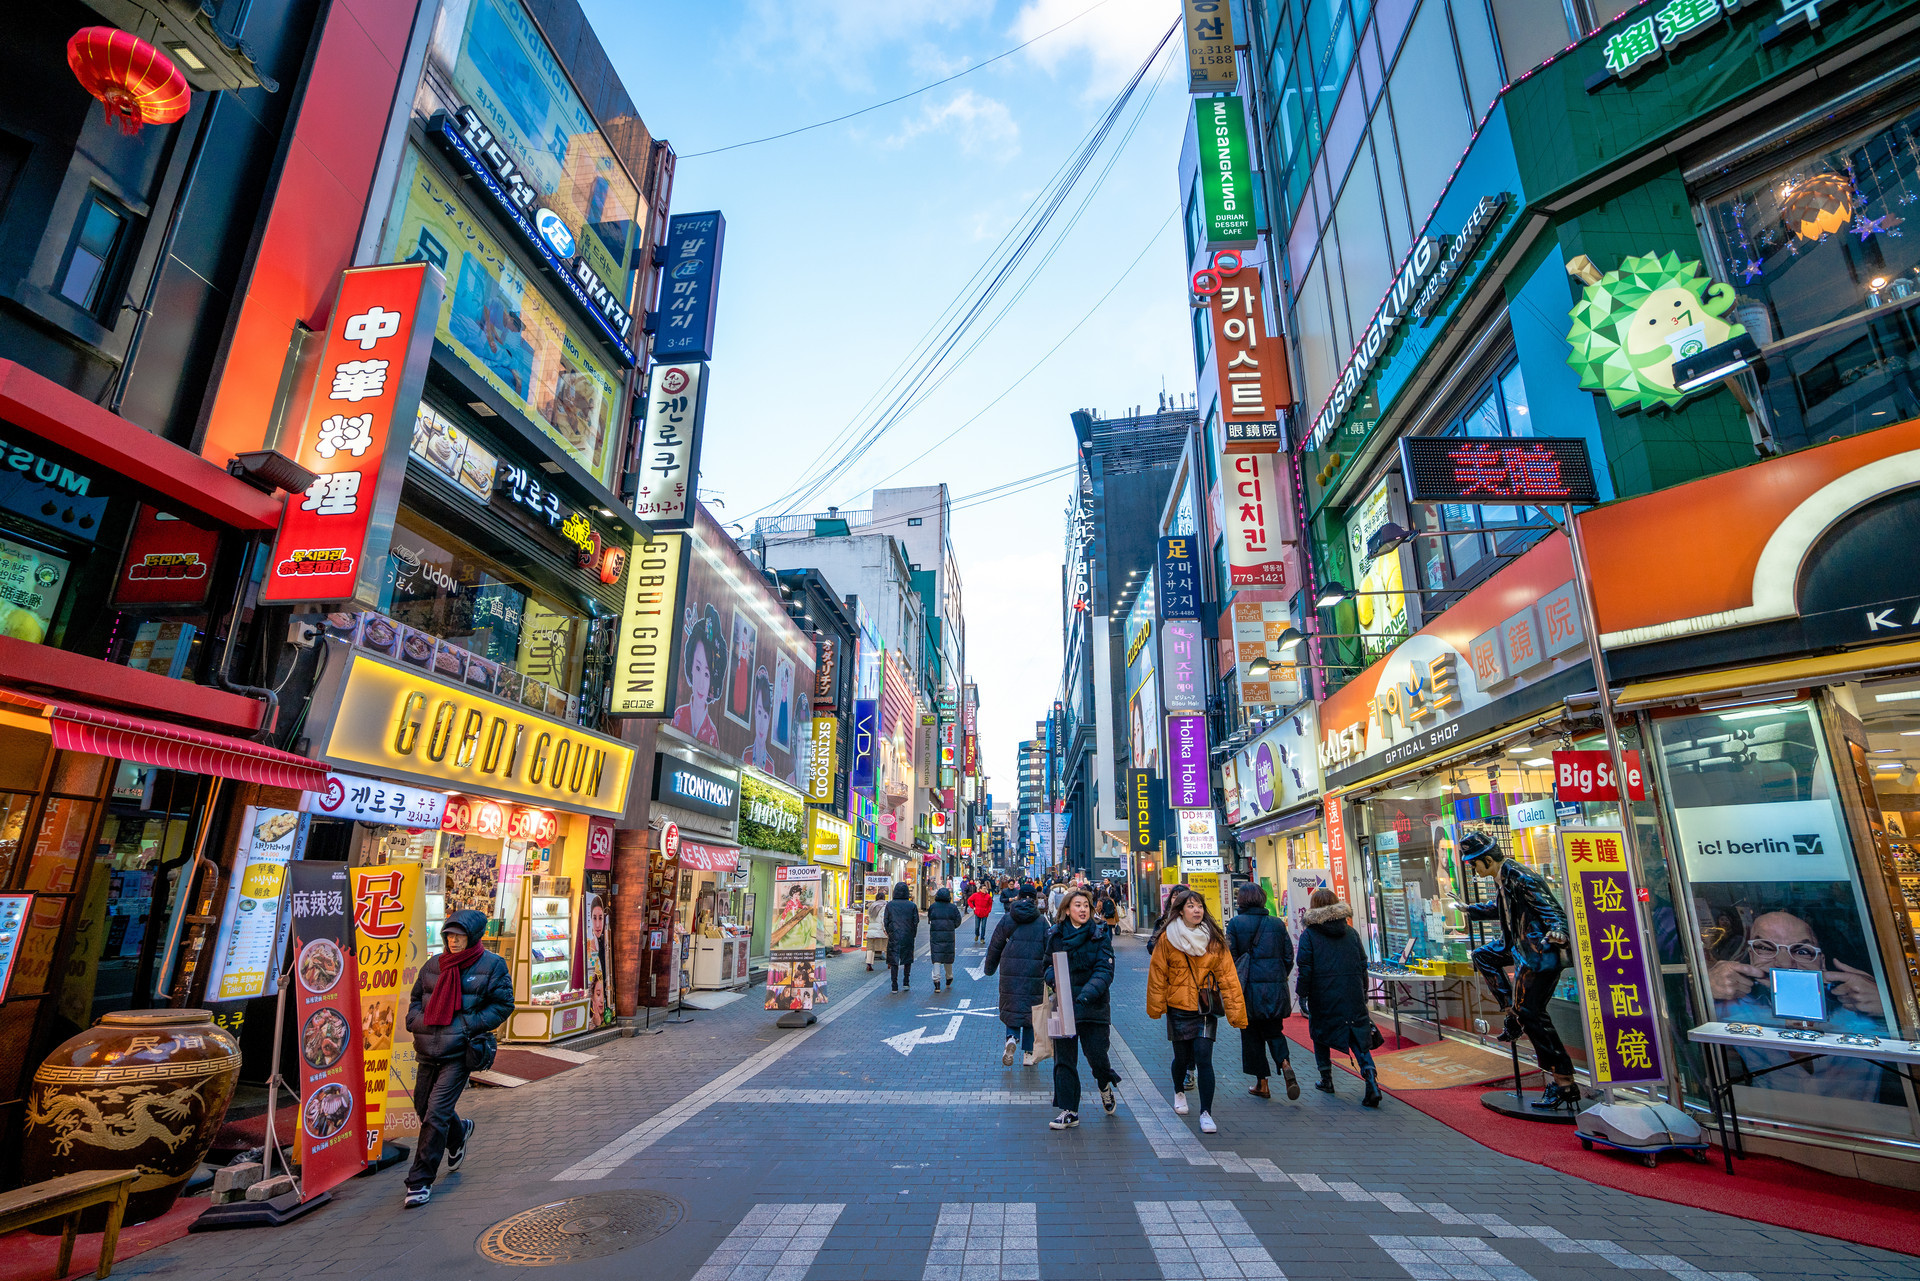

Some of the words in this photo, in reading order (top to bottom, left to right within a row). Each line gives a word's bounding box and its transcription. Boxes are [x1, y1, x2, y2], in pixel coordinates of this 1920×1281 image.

[503, 0, 569, 102] ondition
[1191, 45, 1231, 55] 02.318
[1199, 55, 1232, 65] 1588
[675, 219, 713, 236] 컨디션
[1215, 220, 1249, 228] DESSERT
[1216, 213, 1244, 221] DURIAN
[680, 238, 706, 258] 발
[1412, 273, 1439, 318] 두리안
[1449, 195, 1488, 262] COFFEE
[556, 262, 589, 306] 755-4455
[577, 259, 632, 337] 마사지
[670, 280, 697, 329] 마사지
[1221, 286, 1266, 416] 카이스트
[300, 306, 401, 516] 中華料理
[656, 396, 688, 478] 겐로쿠
[1228, 424, 1278, 437] 眼鏡院
[507, 464, 561, 525] 겐로쿠
[1235, 455, 1267, 552] 디디치킨
[636, 502, 685, 516] 꼬치구이
[1167, 539, 1190, 560] 足
[1233, 573, 1284, 583] 779-1421
[1262, 564, 1283, 573] 명동점
[387, 572, 416, 595] うどん
[1165, 562, 1178, 608] マッサージ
[1178, 561, 1194, 608] 마사지
[1474, 596, 1575, 681] 眼鏡院
[626, 626, 659, 693] GOUN
[1174, 640, 1194, 681] 비쥬
[1176, 683, 1194, 692] 헤어
[394, 690, 524, 778] GOBDI
[528, 731, 607, 798] GOUN
[855, 713, 873, 771] VDL
[1180, 719, 1194, 758] Holika
[1318, 721, 1367, 770] KAIST
[1385, 741, 1426, 764] OPTICAL
[1430, 723, 1460, 746] SHOP
[815, 721, 831, 798] SKINFOOD
[681, 772, 734, 807] TONYMOLY
[1182, 763, 1196, 804] Holika
[1559, 763, 1592, 793] Big
[351, 786, 406, 819] 겐로쿠
[1136, 774, 1150, 845] CLUBCLIO
[1182, 811, 1196, 820] DD
[1517, 807, 1546, 824] Clalen
[406, 810, 439, 825] 꼬치구이
[443, 803, 471, 830] 50
[477, 808, 502, 834] 50
[509, 814, 531, 838] 50
[536, 818, 556, 841] 50
[747, 796, 798, 837] innisfree
[860, 822, 870, 838] VDL
[1379, 836, 1394, 846] Clalen
[591, 832, 610, 855] 50
[961, 839, 971, 848] BIG
[1570, 838, 1620, 863] 美瞳
[1698, 840, 1722, 855] ic!
[1727, 838, 1790, 854] berlin
[692, 845, 712, 870] 50
[712, 852, 734, 866] SALE
[1101, 869, 1126, 878] SPAO
[293, 890, 344, 916] 麻辣烫
[355, 869, 405, 939] 足
[226, 984, 243, 994] Take
[244, 983, 257, 993] Out
[210, 1011, 245, 1030] 로쿠
